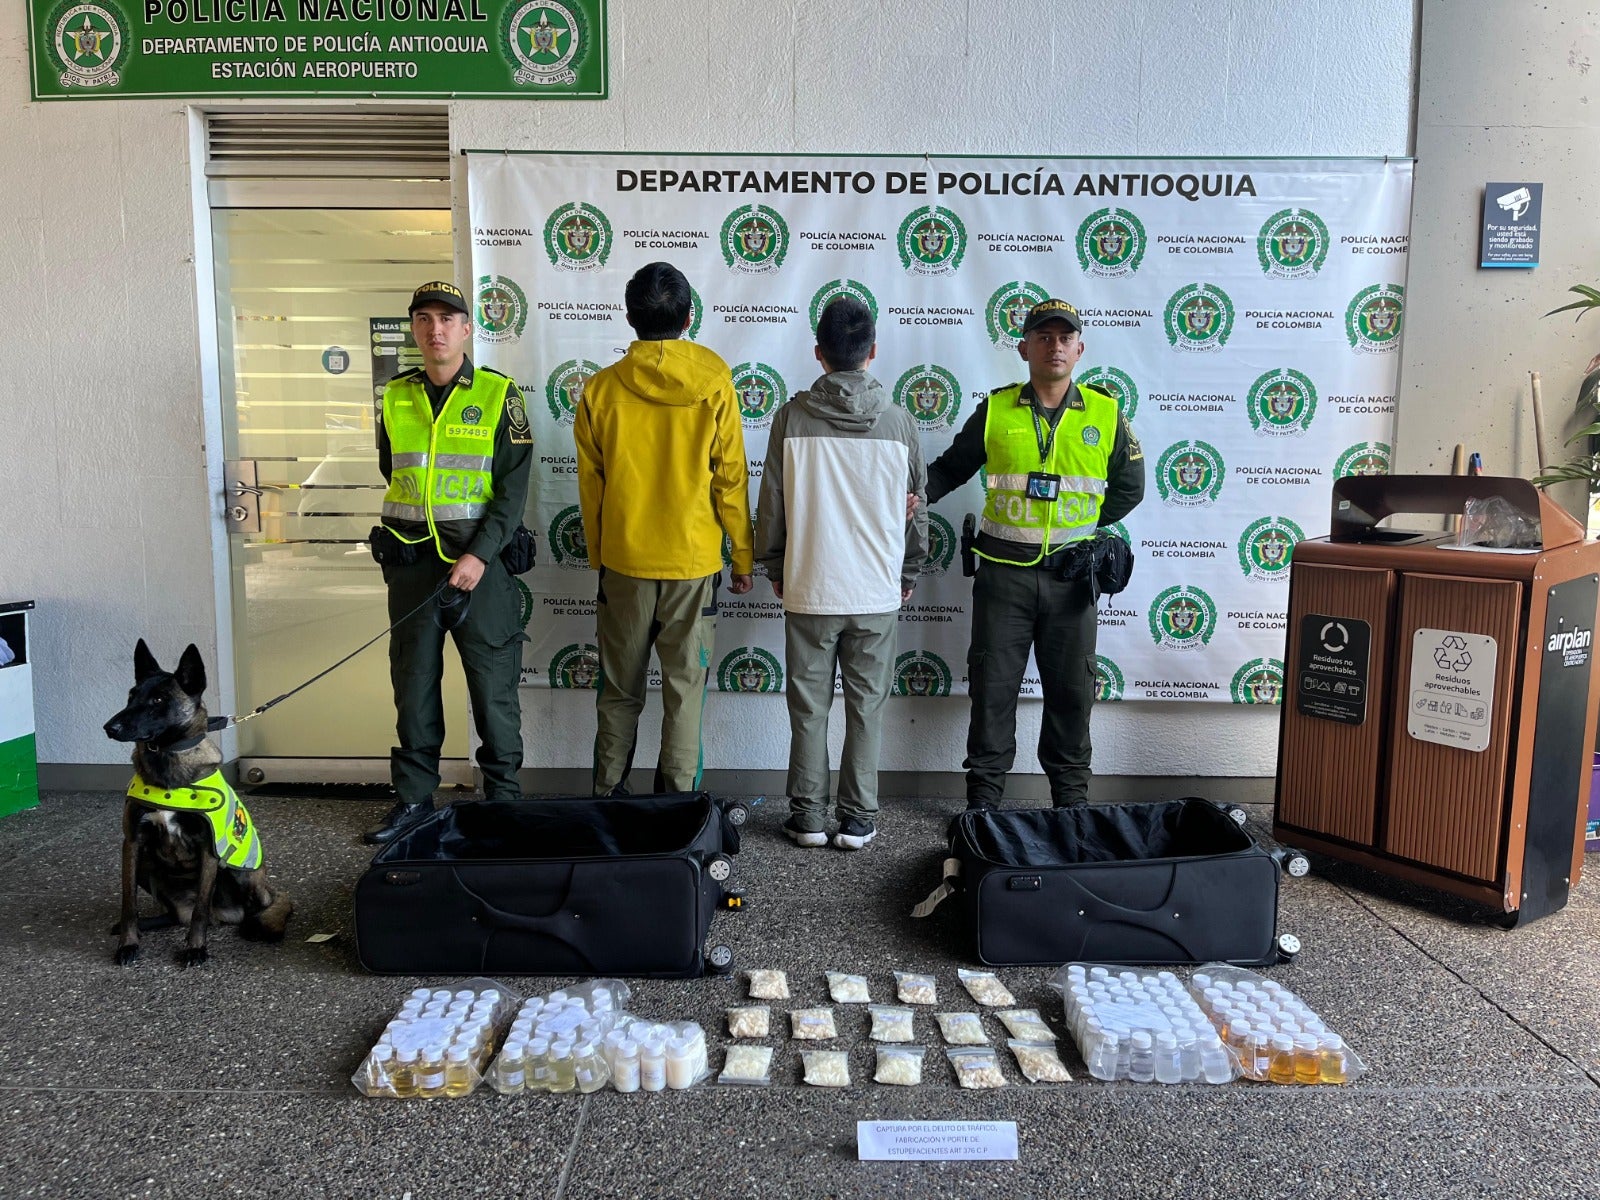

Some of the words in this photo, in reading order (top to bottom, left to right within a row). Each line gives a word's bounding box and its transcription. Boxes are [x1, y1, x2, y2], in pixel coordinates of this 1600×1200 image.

[300, 0, 487, 22] NACIONAL
[142, 37, 278, 54] DEPARTAMENTO
[285, 37, 307, 52] DE
[314, 32, 382, 52] POLICÍA
[388, 36, 488, 53] ANTIOQUIA
[212, 58, 296, 78] ESTACIÓN
[303, 62, 418, 78] AEROPUERTO
[616, 170, 876, 194] DEPARTAMENTO
[886, 172, 927, 194] DE
[938, 167, 1065, 196] POLICÍA
[1073, 174, 1257, 201] ANTIOQUIA
[623, 229, 660, 238] POLICÍA
[800, 231, 836, 240] POLICÍA
[978, 232, 1014, 241] POLICÍA
[1157, 234, 1195, 243] POLICÍA
[1341, 234, 1378, 243] POLICÍA
[415, 283, 462, 299] POLICIA
[538, 301, 574, 310] POLICÍA
[713, 304, 749, 313] POLICÍA
[1033, 301, 1076, 316] POLICIA
[889, 306, 925, 315] POLICÍA
[1080, 308, 1102, 316] LICÍA
[1245, 309, 1283, 318] POLICÍA
[1149, 392, 1186, 401] POLICÍA
[1328, 394, 1365, 403] POLICÍA
[448, 427, 488, 438] 597489
[1236, 465, 1272, 474] POLICÍA
[1141, 539, 1178, 548] POLICÍA
[1548, 618, 1591, 656] airplan
[1313, 654, 1343, 664] Residuos
[1309, 663, 1357, 676] aprovechables
[1135, 679, 1171, 688] POLICÍA
[1436, 674, 1471, 685] Residuos
[1424, 682, 1481, 696] aprovechables
